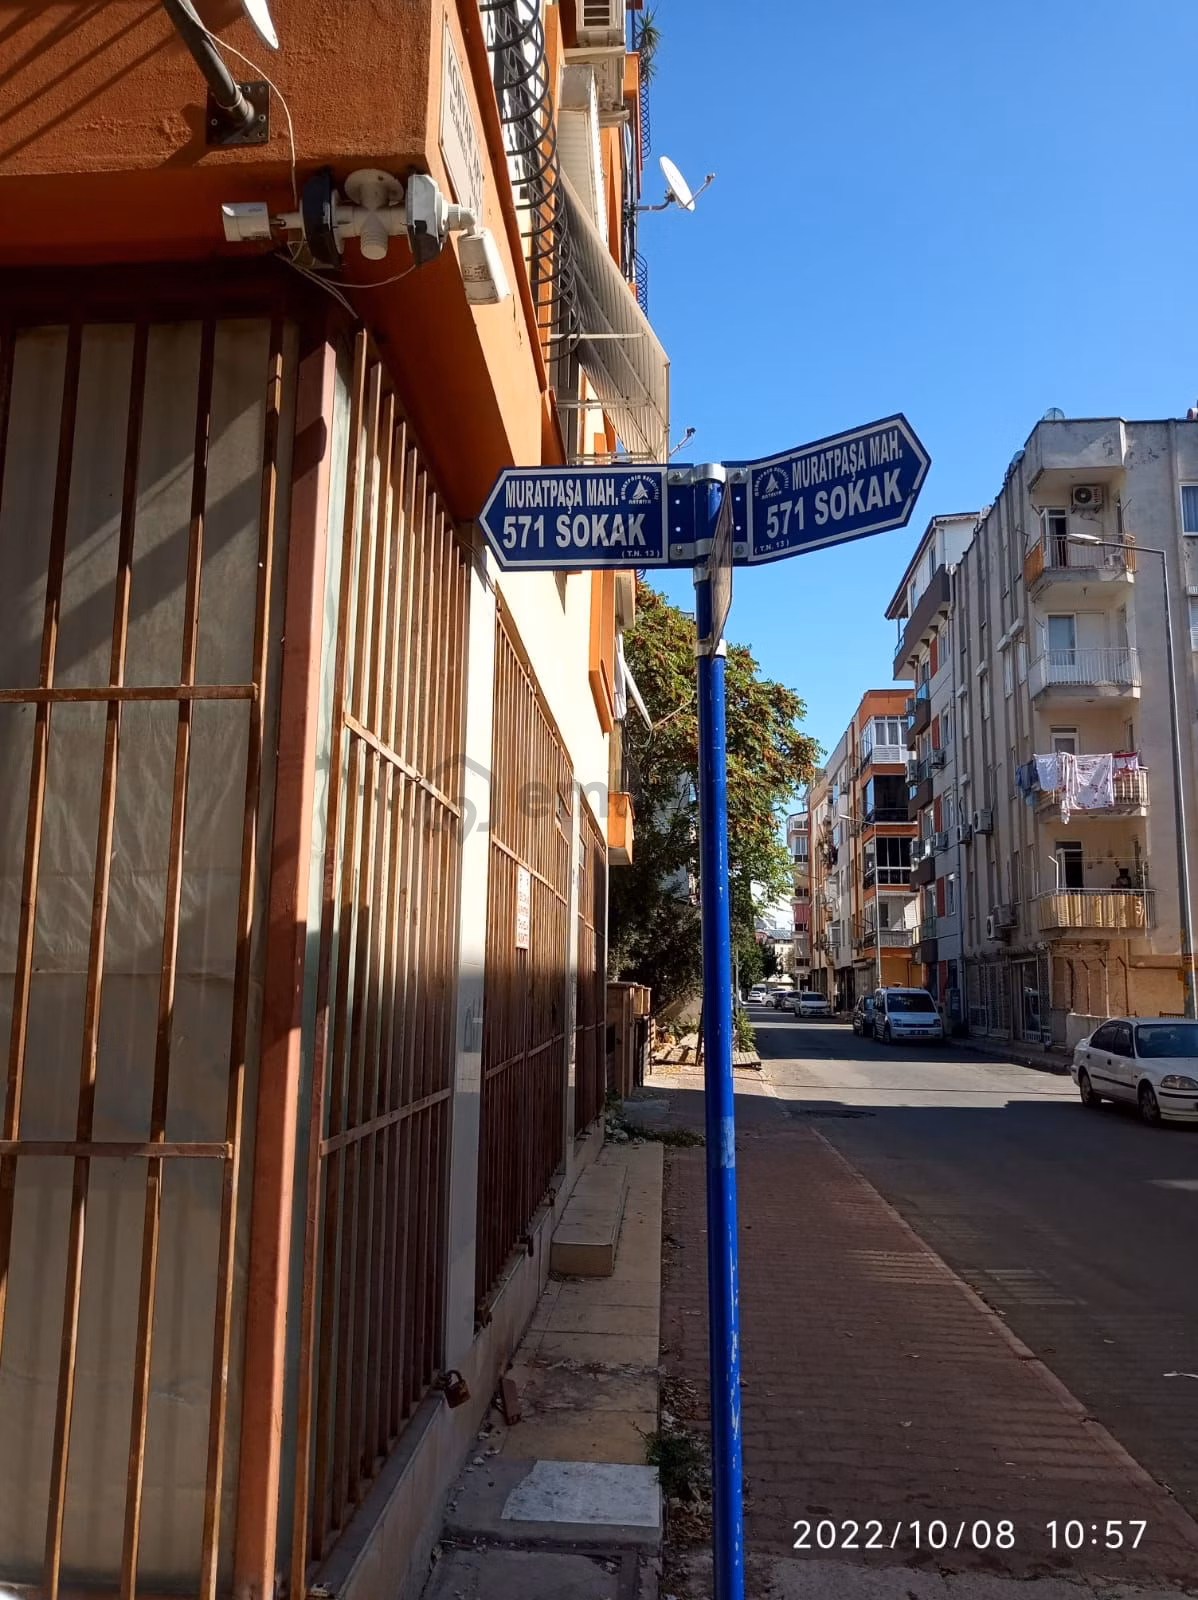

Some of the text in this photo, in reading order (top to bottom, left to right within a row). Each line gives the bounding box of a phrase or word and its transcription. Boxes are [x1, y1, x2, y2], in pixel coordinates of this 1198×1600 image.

[792, 440, 867, 491] MURATPAŞA
[870, 429, 903, 467] MAH.
[505, 478, 619, 514] MURATPAŞA MAH.
[766, 496, 805, 539] 571
[814, 467, 902, 526] SOKAK
[503, 513, 647, 549] 571 SOKAK
